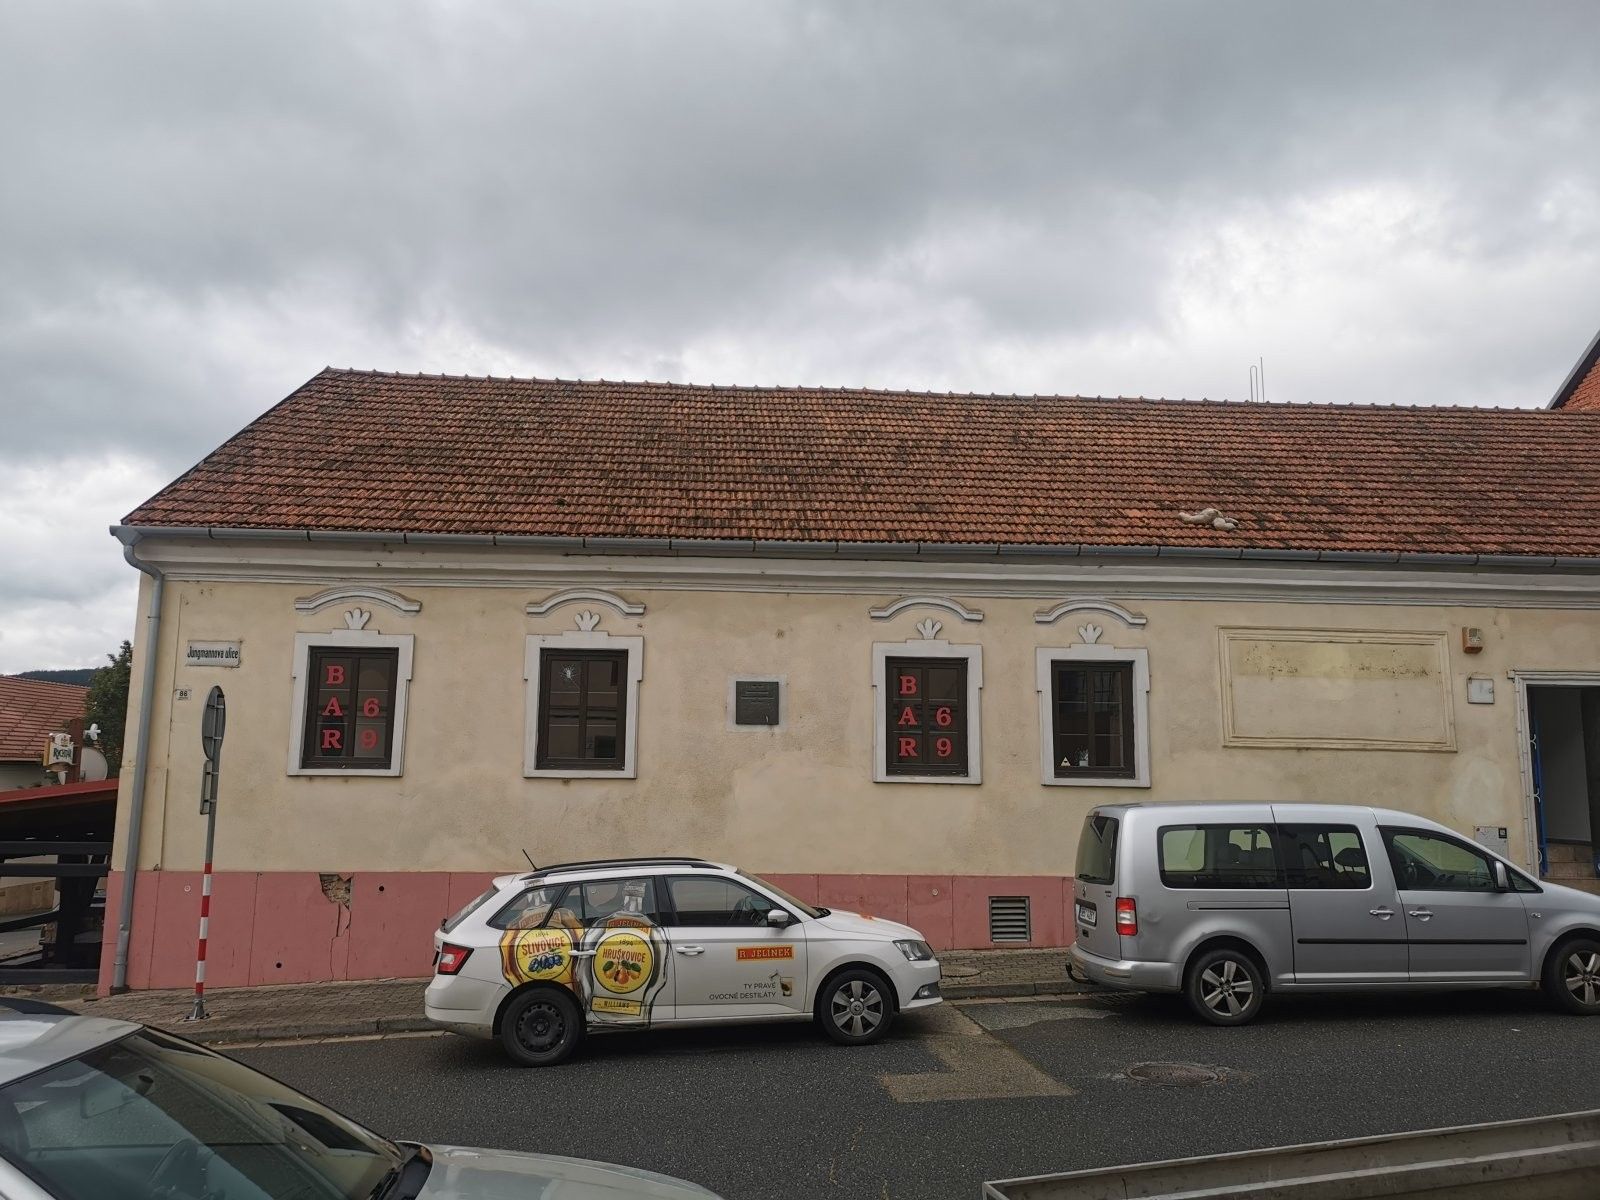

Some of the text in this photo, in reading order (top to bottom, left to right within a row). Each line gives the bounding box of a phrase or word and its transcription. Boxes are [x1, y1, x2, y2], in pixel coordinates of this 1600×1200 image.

[187, 646, 239, 660] Jungmannova ulice
[522, 937, 565, 956] SLIVOVICE
[602, 948, 646, 963] HRUŠKOVICE
[754, 982, 776, 990] PRAVÉ
[709, 991, 777, 1000] OVOCNÉ DESTILÁTY
